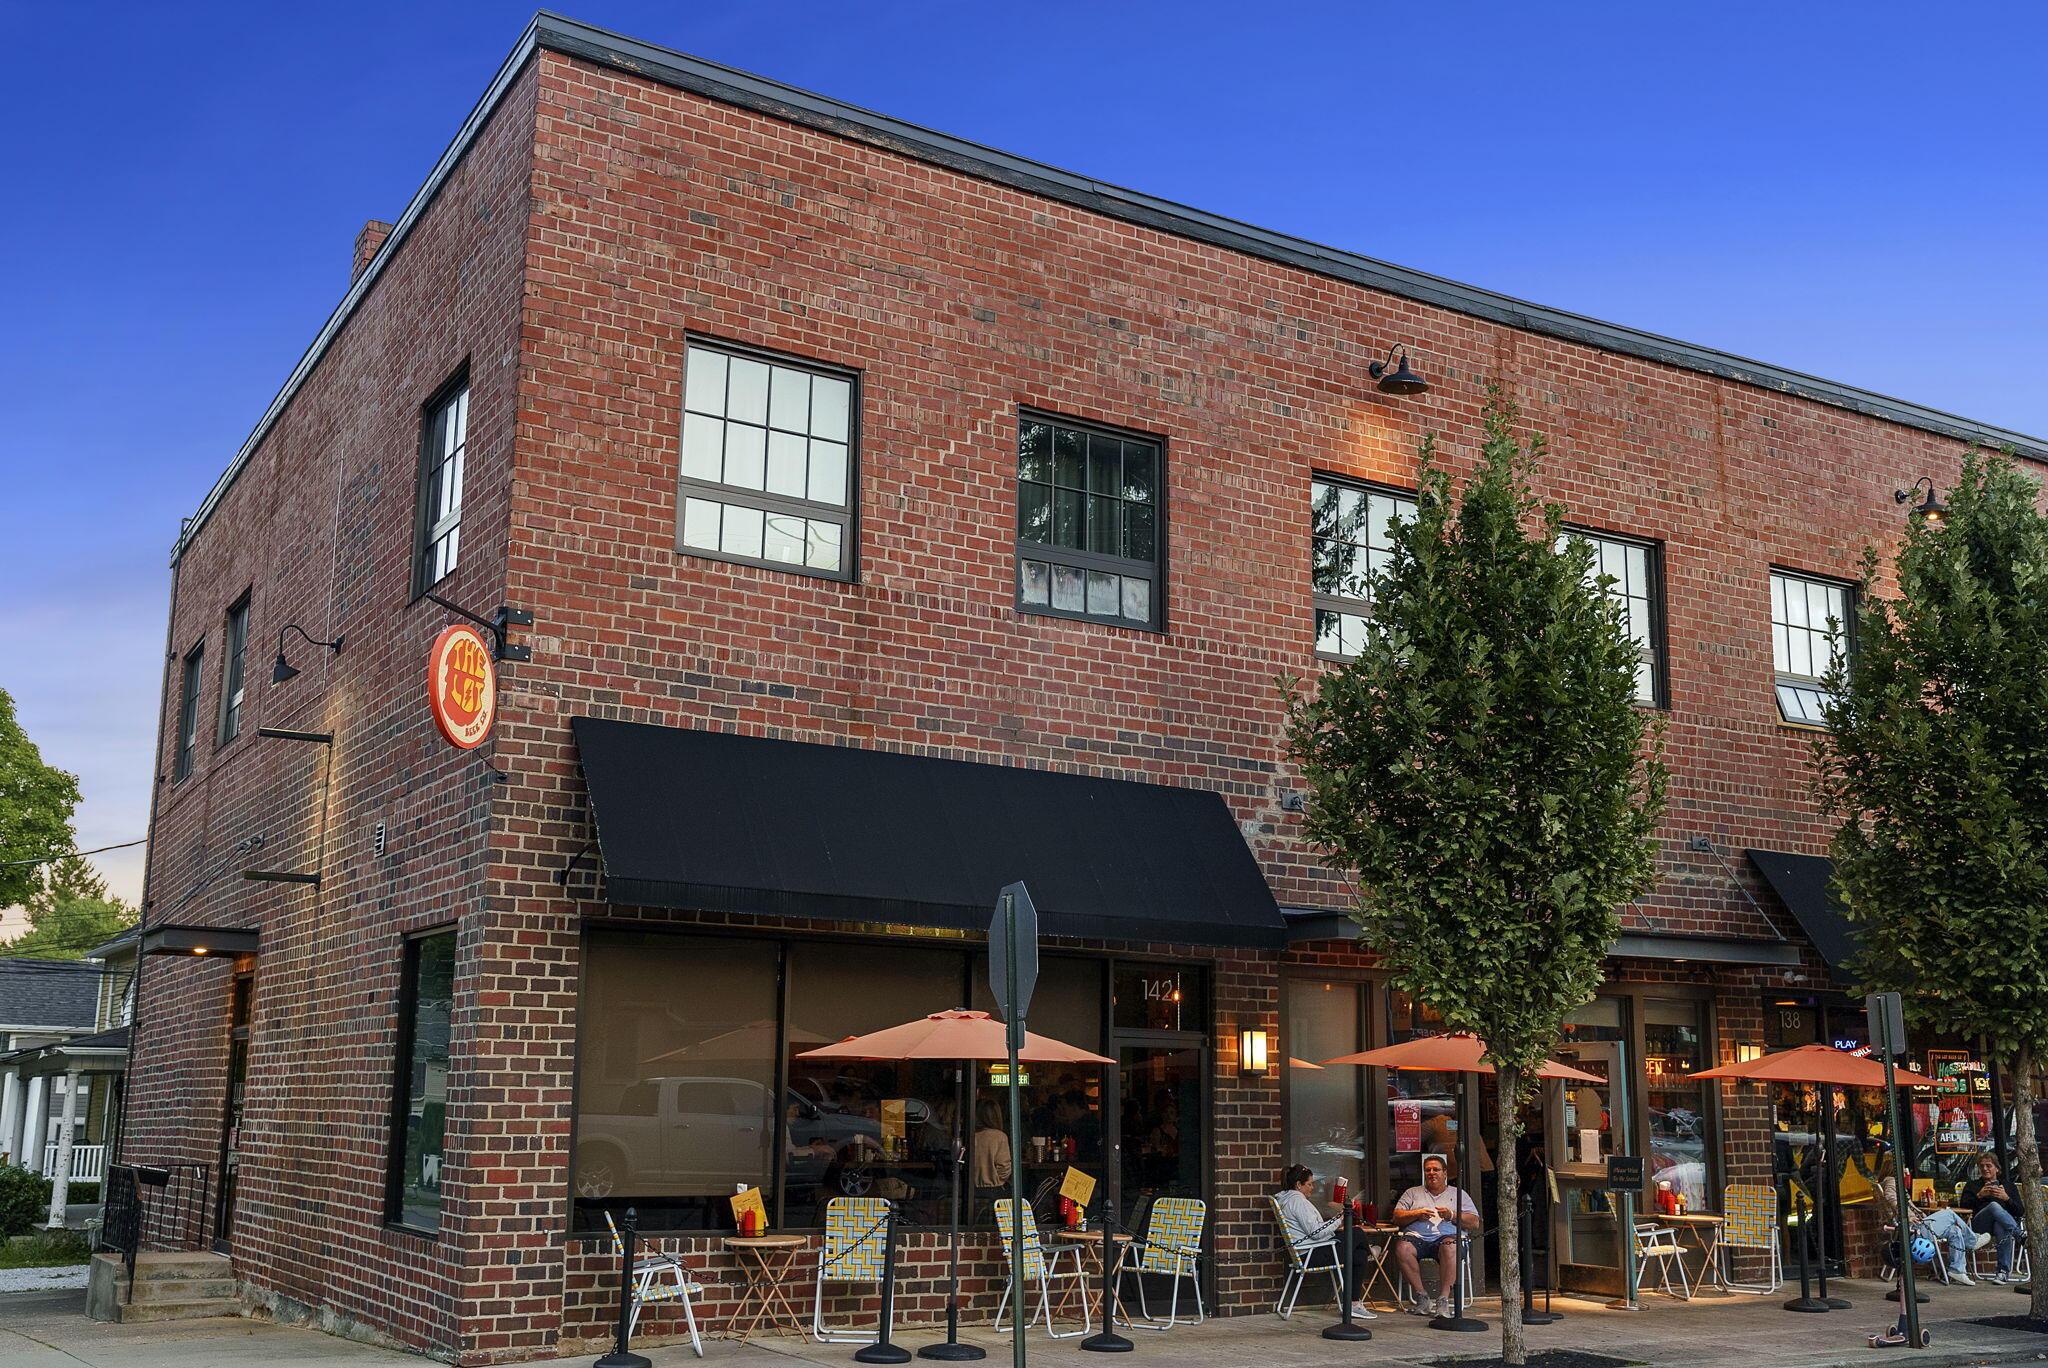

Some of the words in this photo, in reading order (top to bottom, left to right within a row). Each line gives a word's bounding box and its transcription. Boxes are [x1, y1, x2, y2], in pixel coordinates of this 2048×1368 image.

[453, 638, 486, 679] THE
[465, 723, 481, 737] BEER
[1141, 979, 1173, 1001] 142
[1779, 1011, 1801, 1029] 138
[1834, 1040, 1857, 1049] PLAY
[992, 1074, 1007, 1084] COLD
